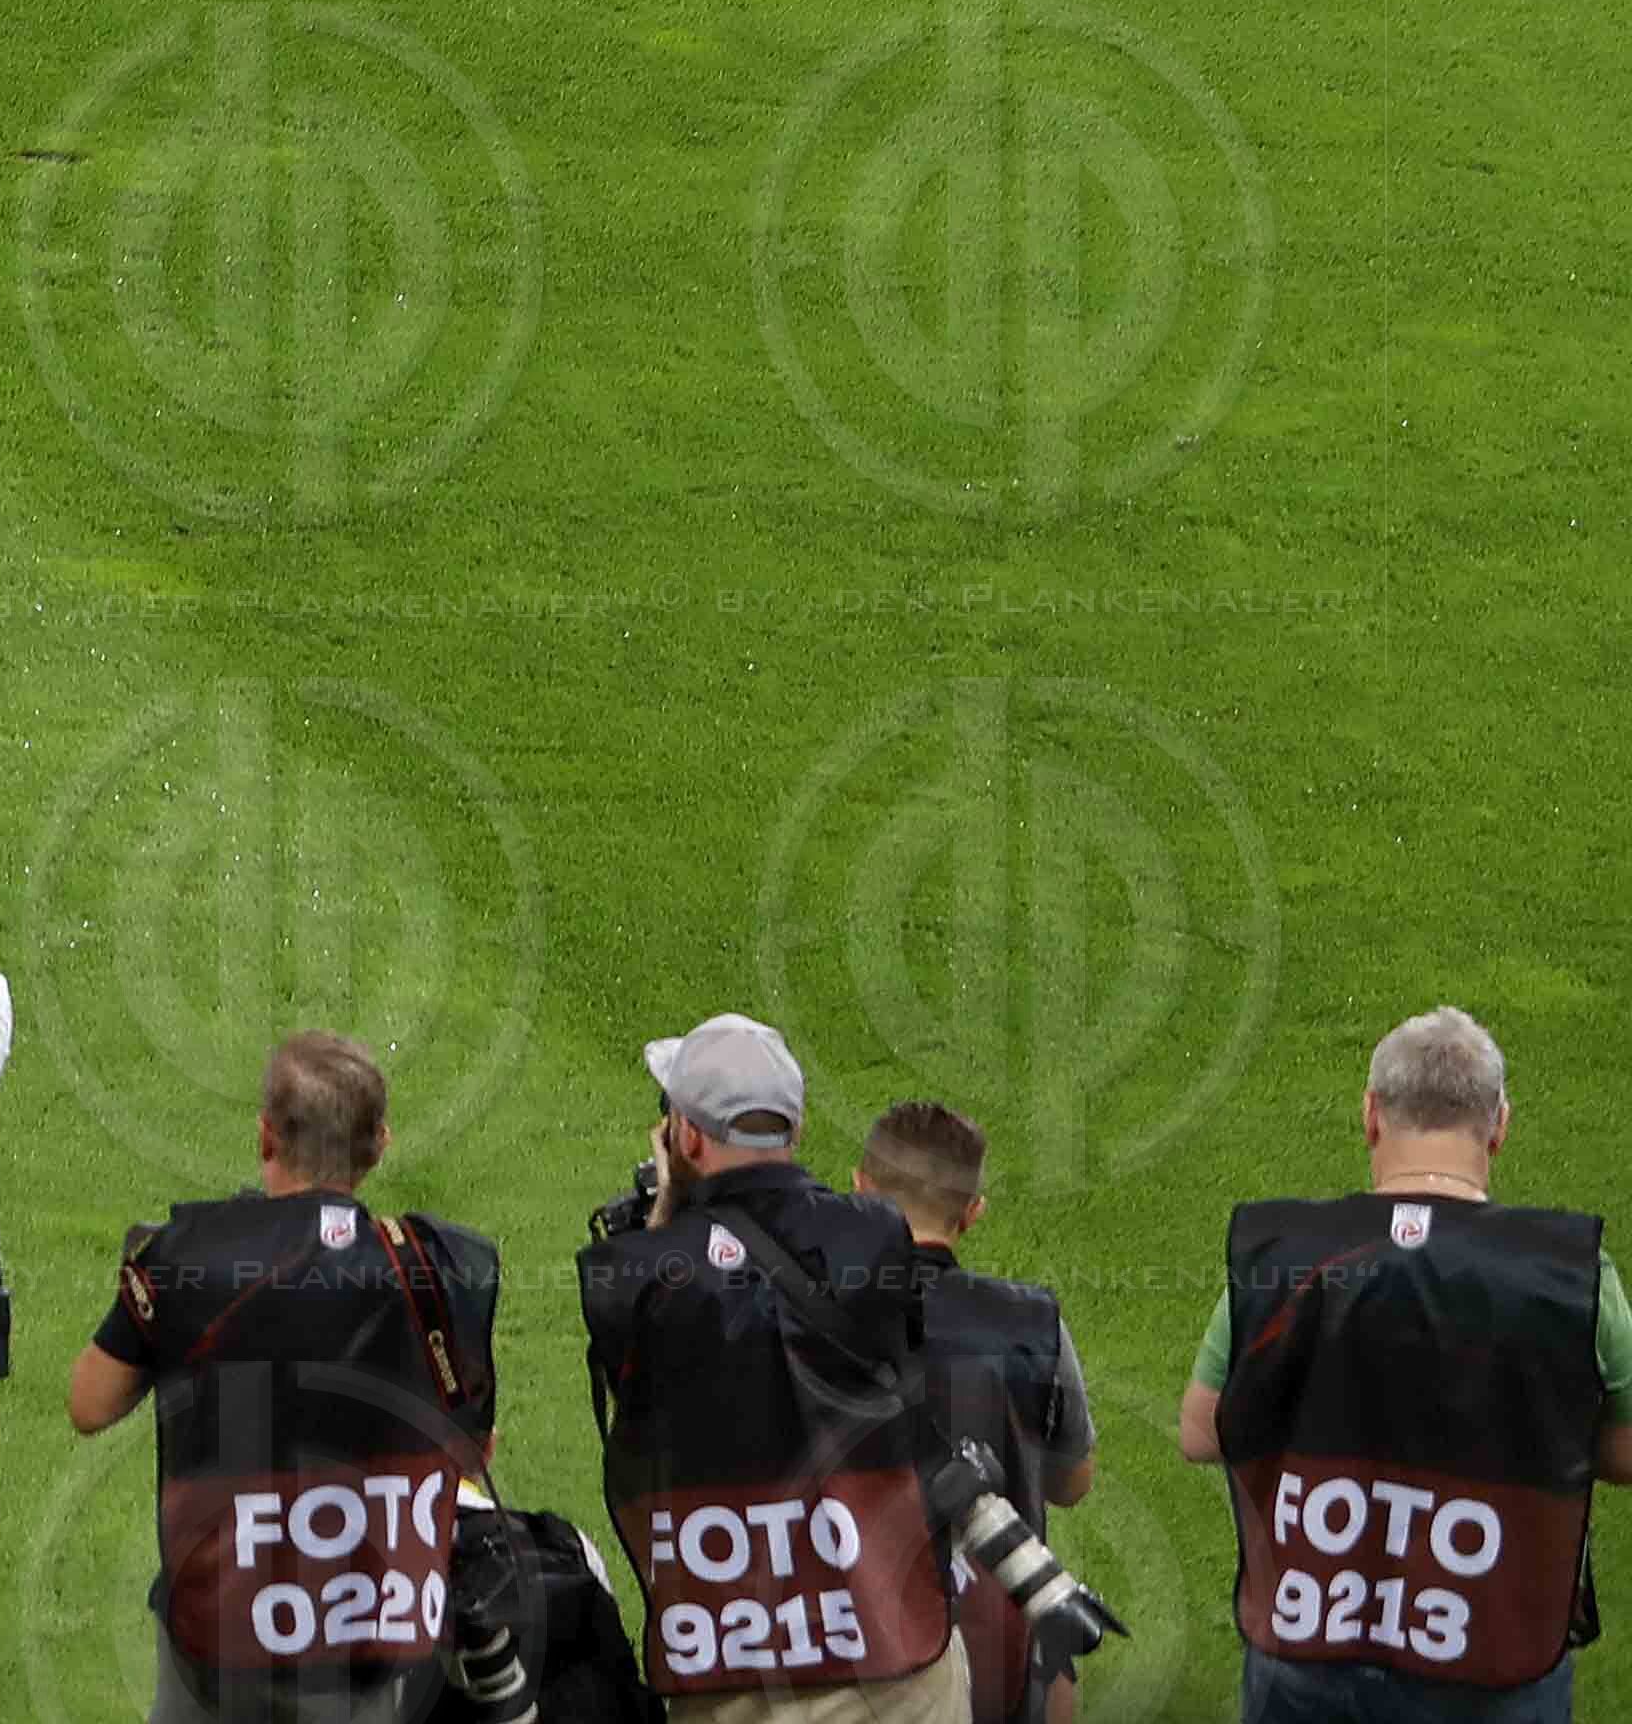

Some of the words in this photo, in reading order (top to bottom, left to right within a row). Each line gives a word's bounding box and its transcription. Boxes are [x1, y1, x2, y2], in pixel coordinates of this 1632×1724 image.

[1274, 1472, 1503, 1577] FOTO
[251, 1570, 445, 1655] 0220
[660, 1590, 866, 1677] 9215
[1271, 1570, 1471, 1662] 9213
